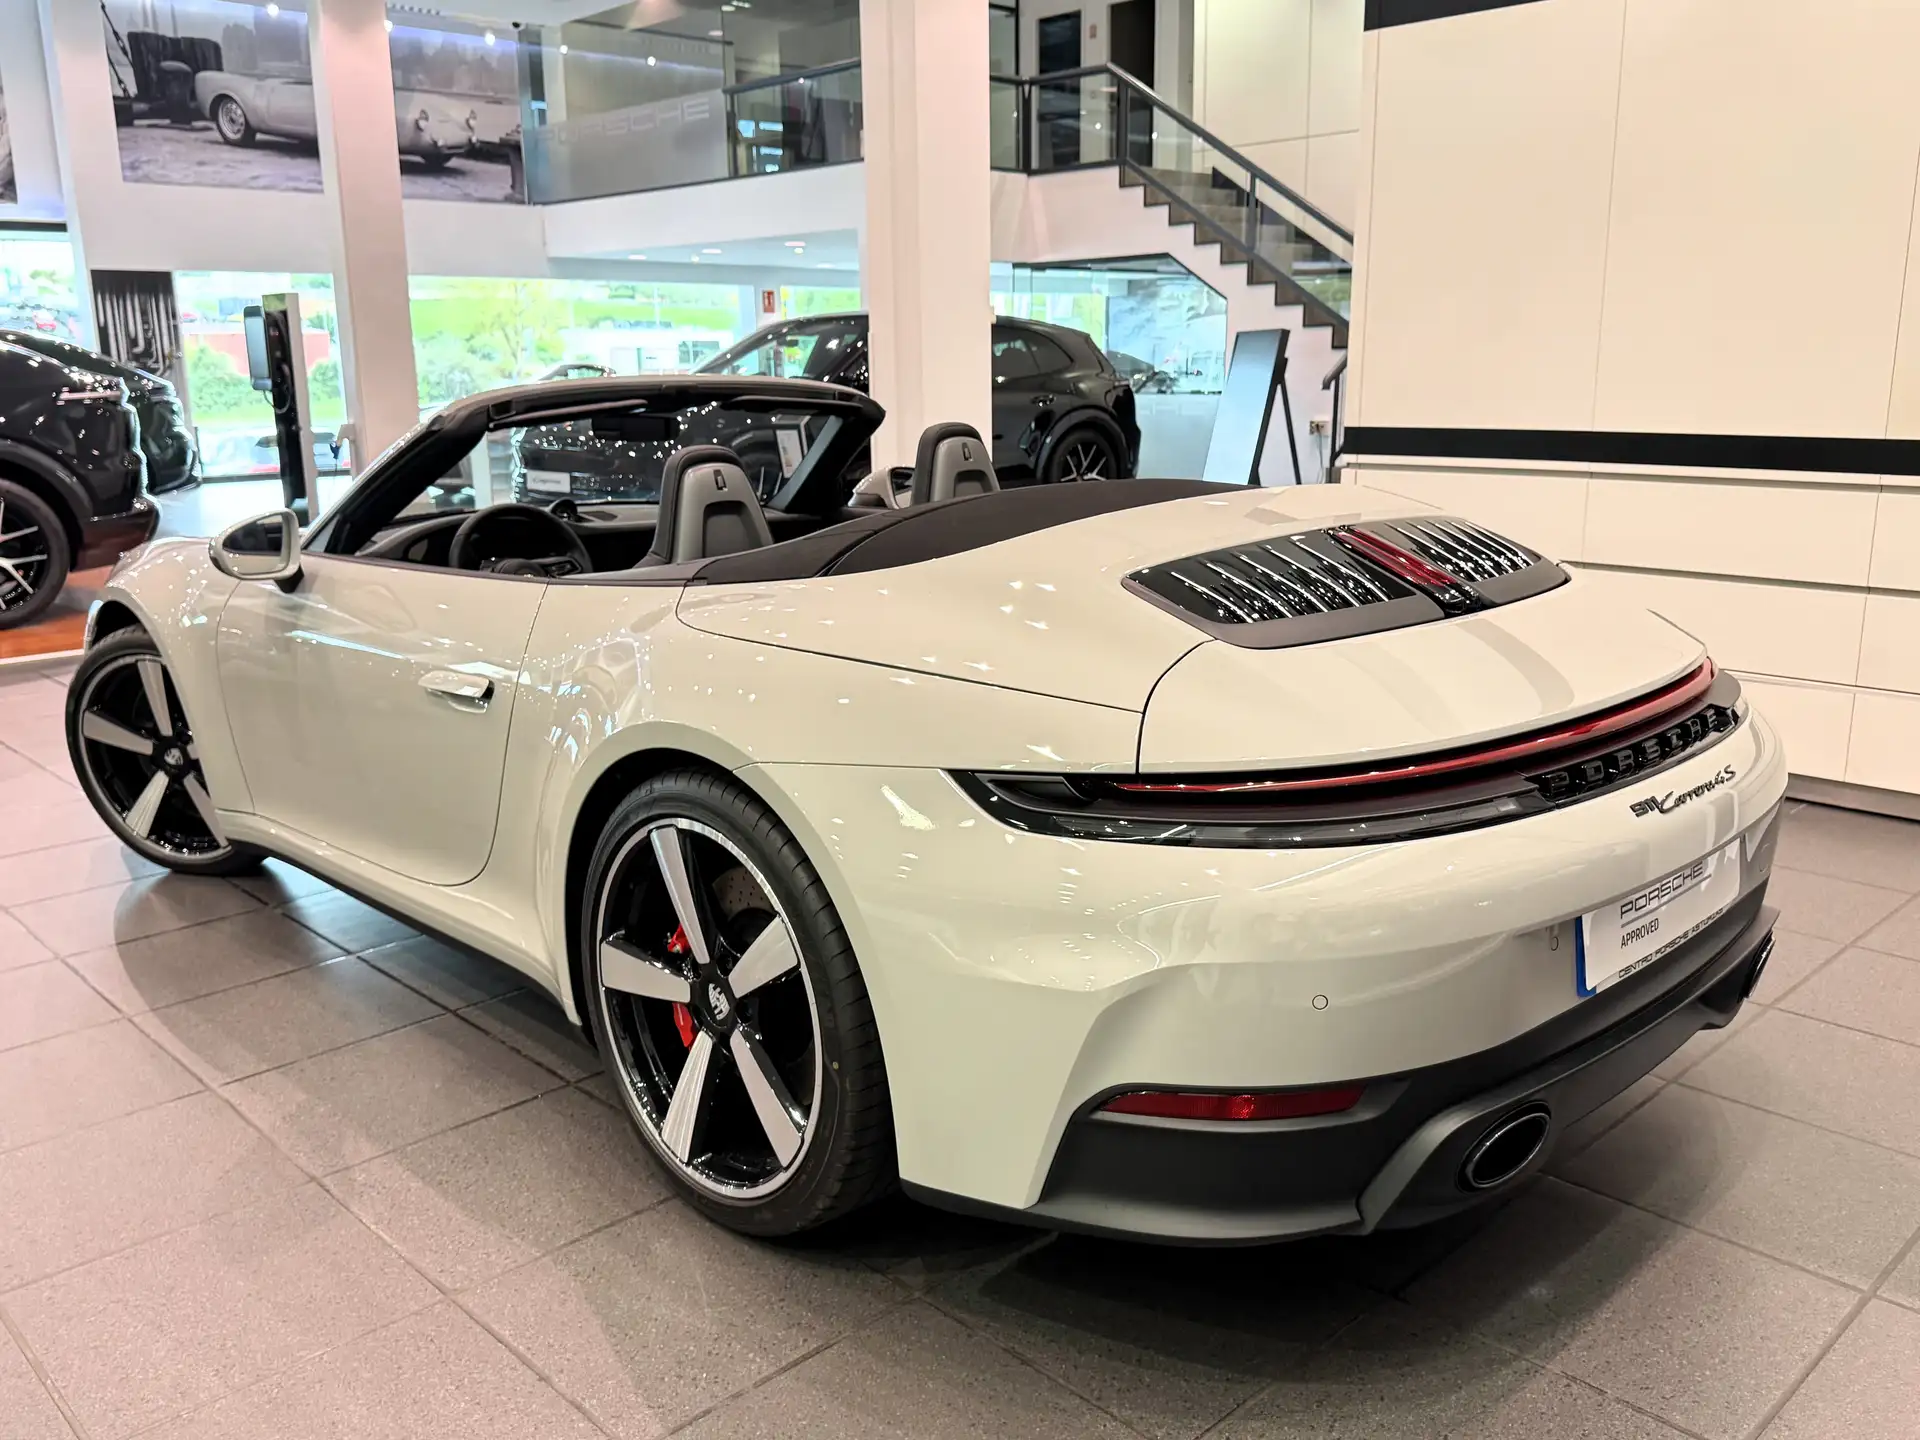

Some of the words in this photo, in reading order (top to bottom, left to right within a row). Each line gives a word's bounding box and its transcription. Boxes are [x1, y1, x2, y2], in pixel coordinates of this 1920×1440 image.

[1546, 708, 1718, 796] PORSCHE
[1629, 795, 1661, 818] 911
[1620, 861, 1704, 920] PORSCHE
[1618, 952, 1653, 979] CENTRO
[1655, 931, 1689, 957] PORSCHE
[1620, 917, 1660, 949] APPROVED
